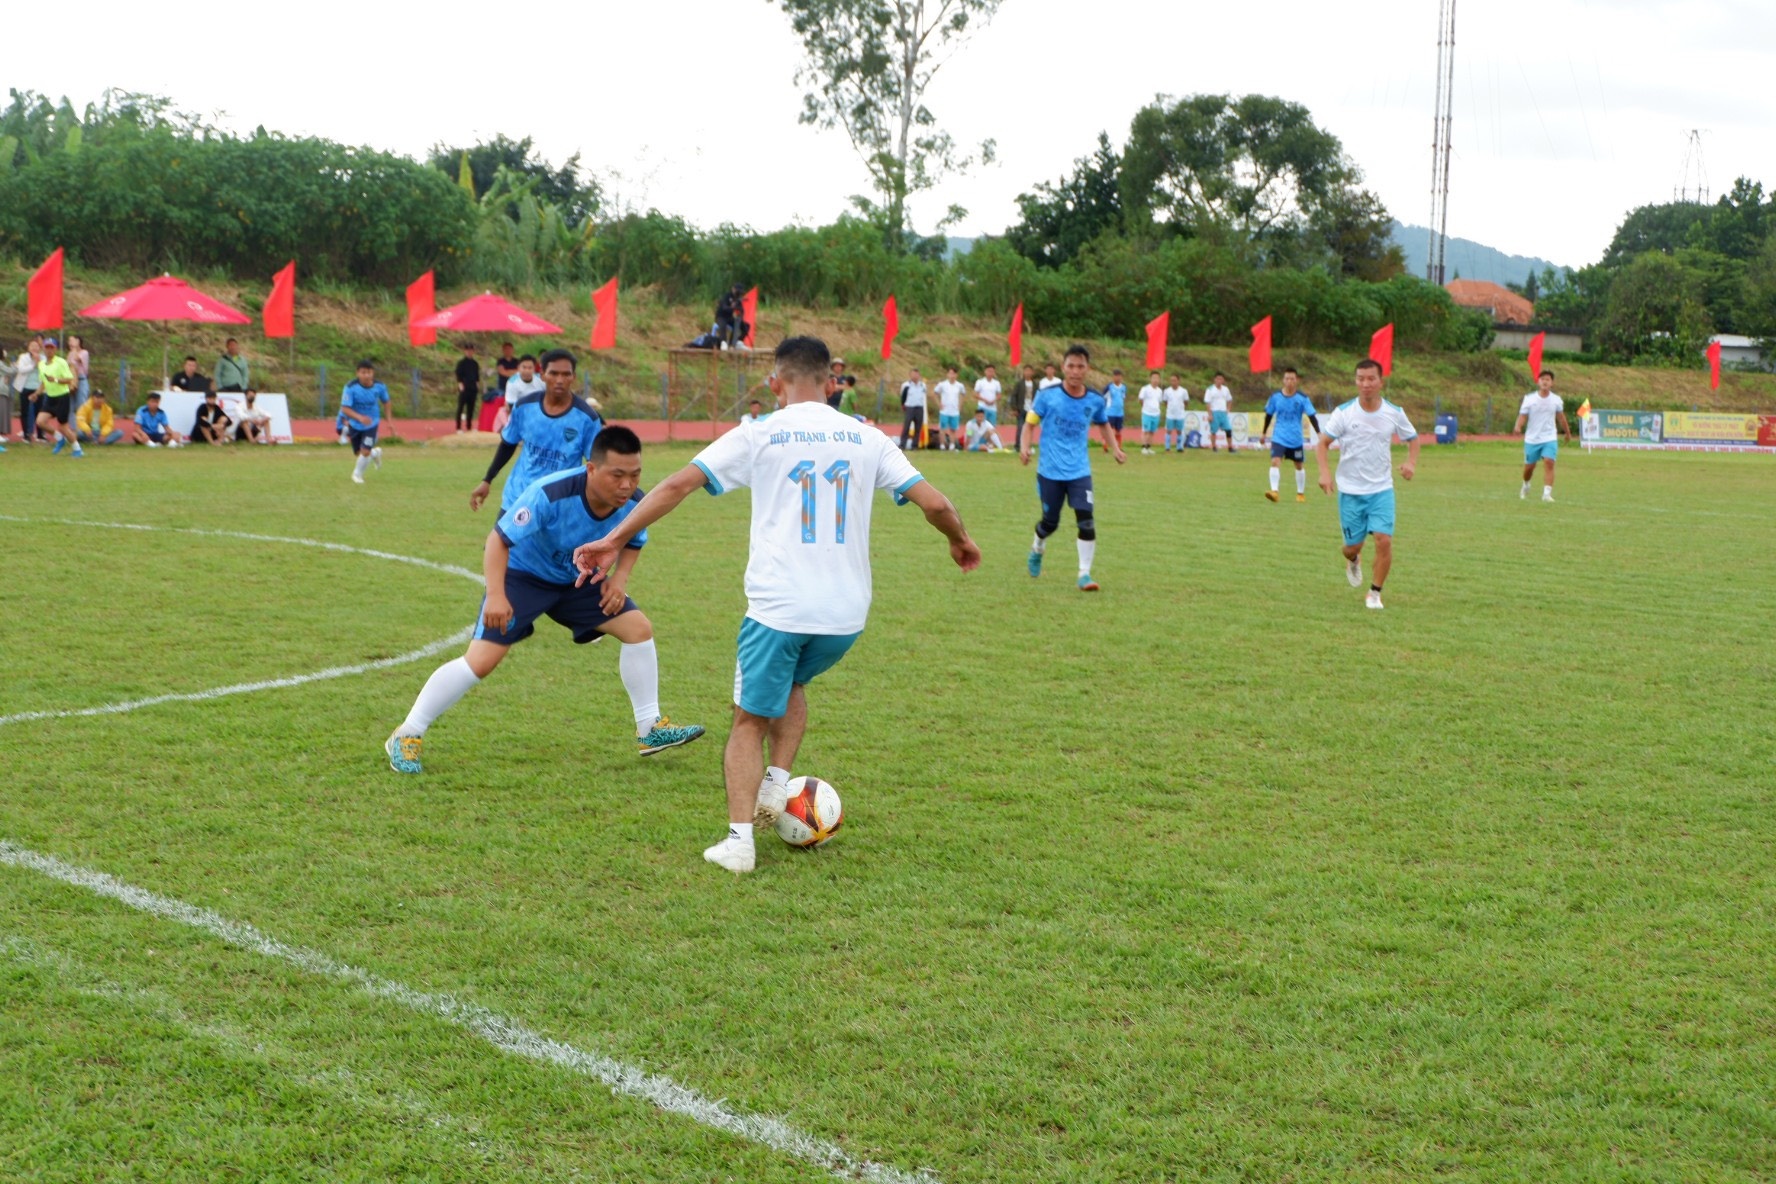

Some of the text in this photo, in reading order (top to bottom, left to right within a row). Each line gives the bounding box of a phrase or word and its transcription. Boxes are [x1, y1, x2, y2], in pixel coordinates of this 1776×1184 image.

[1608, 415, 1634, 425] LARUE
[770, 429, 791, 447] HIỆP
[793, 431, 827, 446] THẠNH
[1603, 428, 1639, 438] SMOOTH
[788, 460, 851, 544] 11
